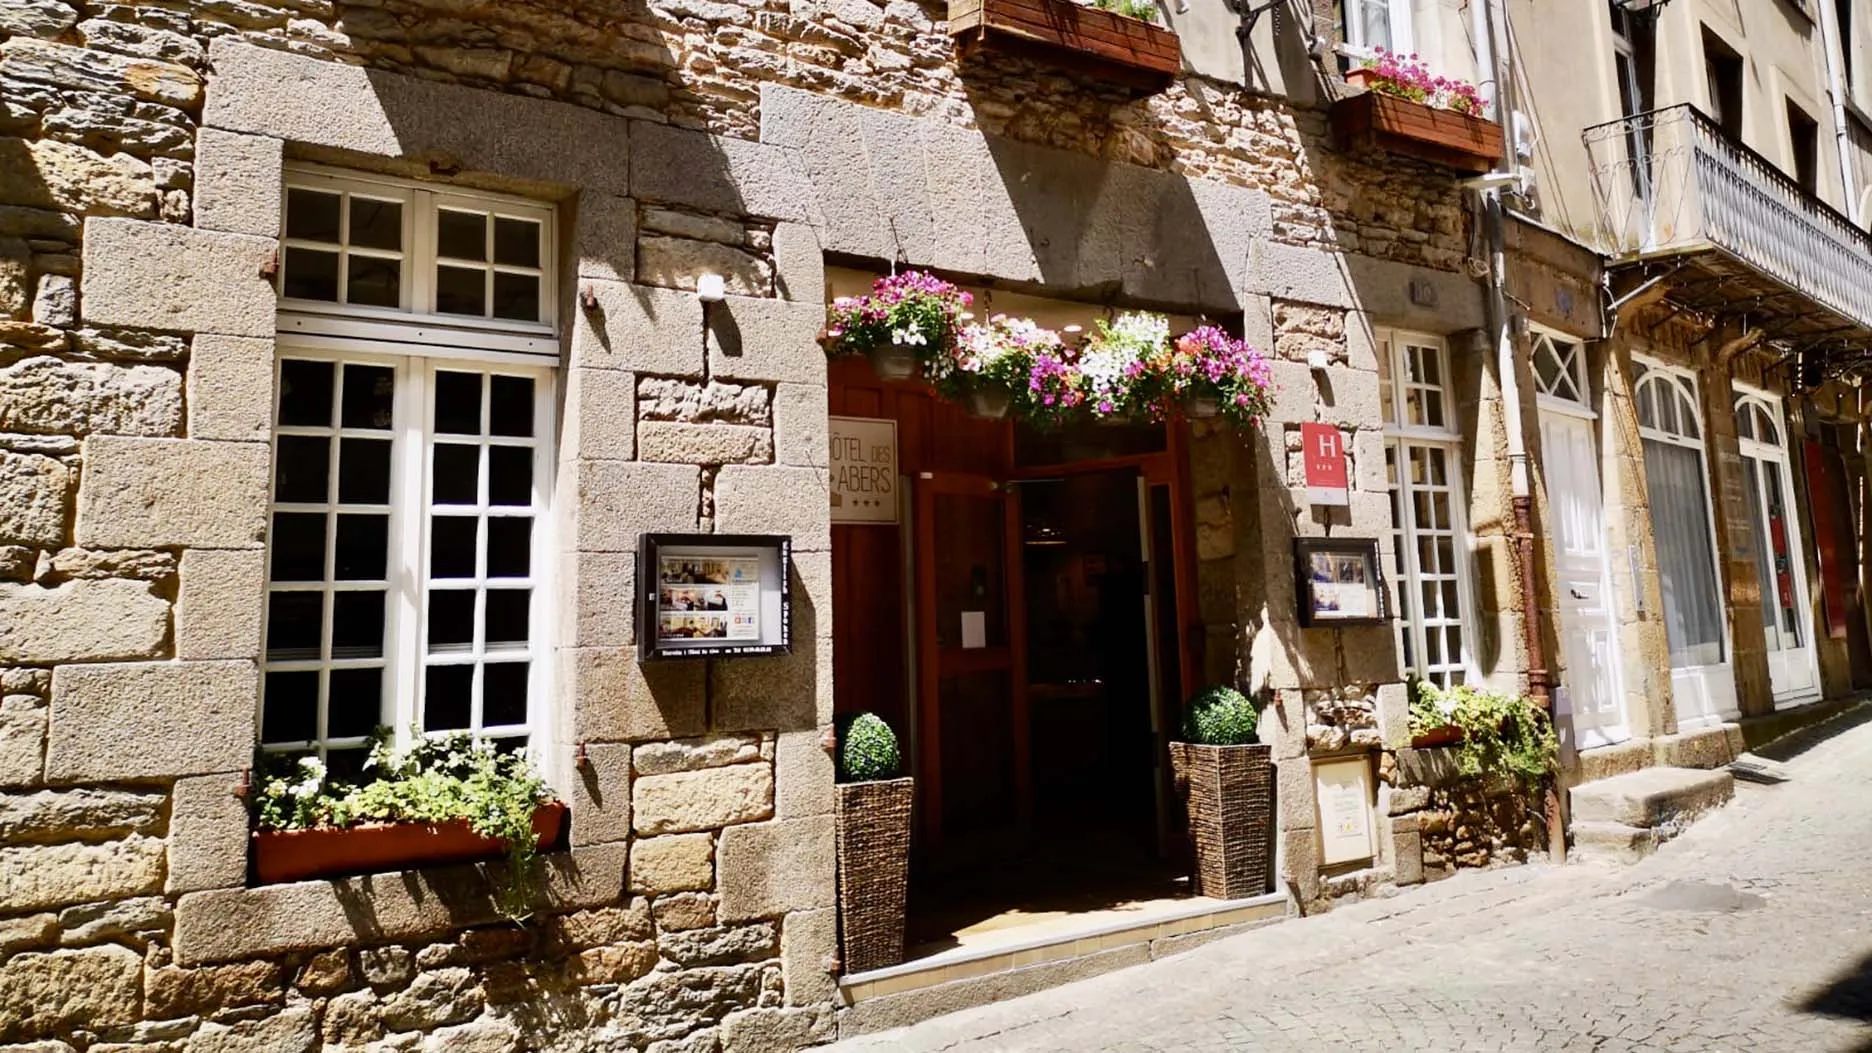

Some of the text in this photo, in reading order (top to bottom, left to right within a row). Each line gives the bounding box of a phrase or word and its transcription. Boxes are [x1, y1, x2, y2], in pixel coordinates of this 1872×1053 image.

[829, 432, 891, 464] ÔTEL DES
[1318, 434, 1337, 458] H
[838, 465, 892, 493] ABERS
